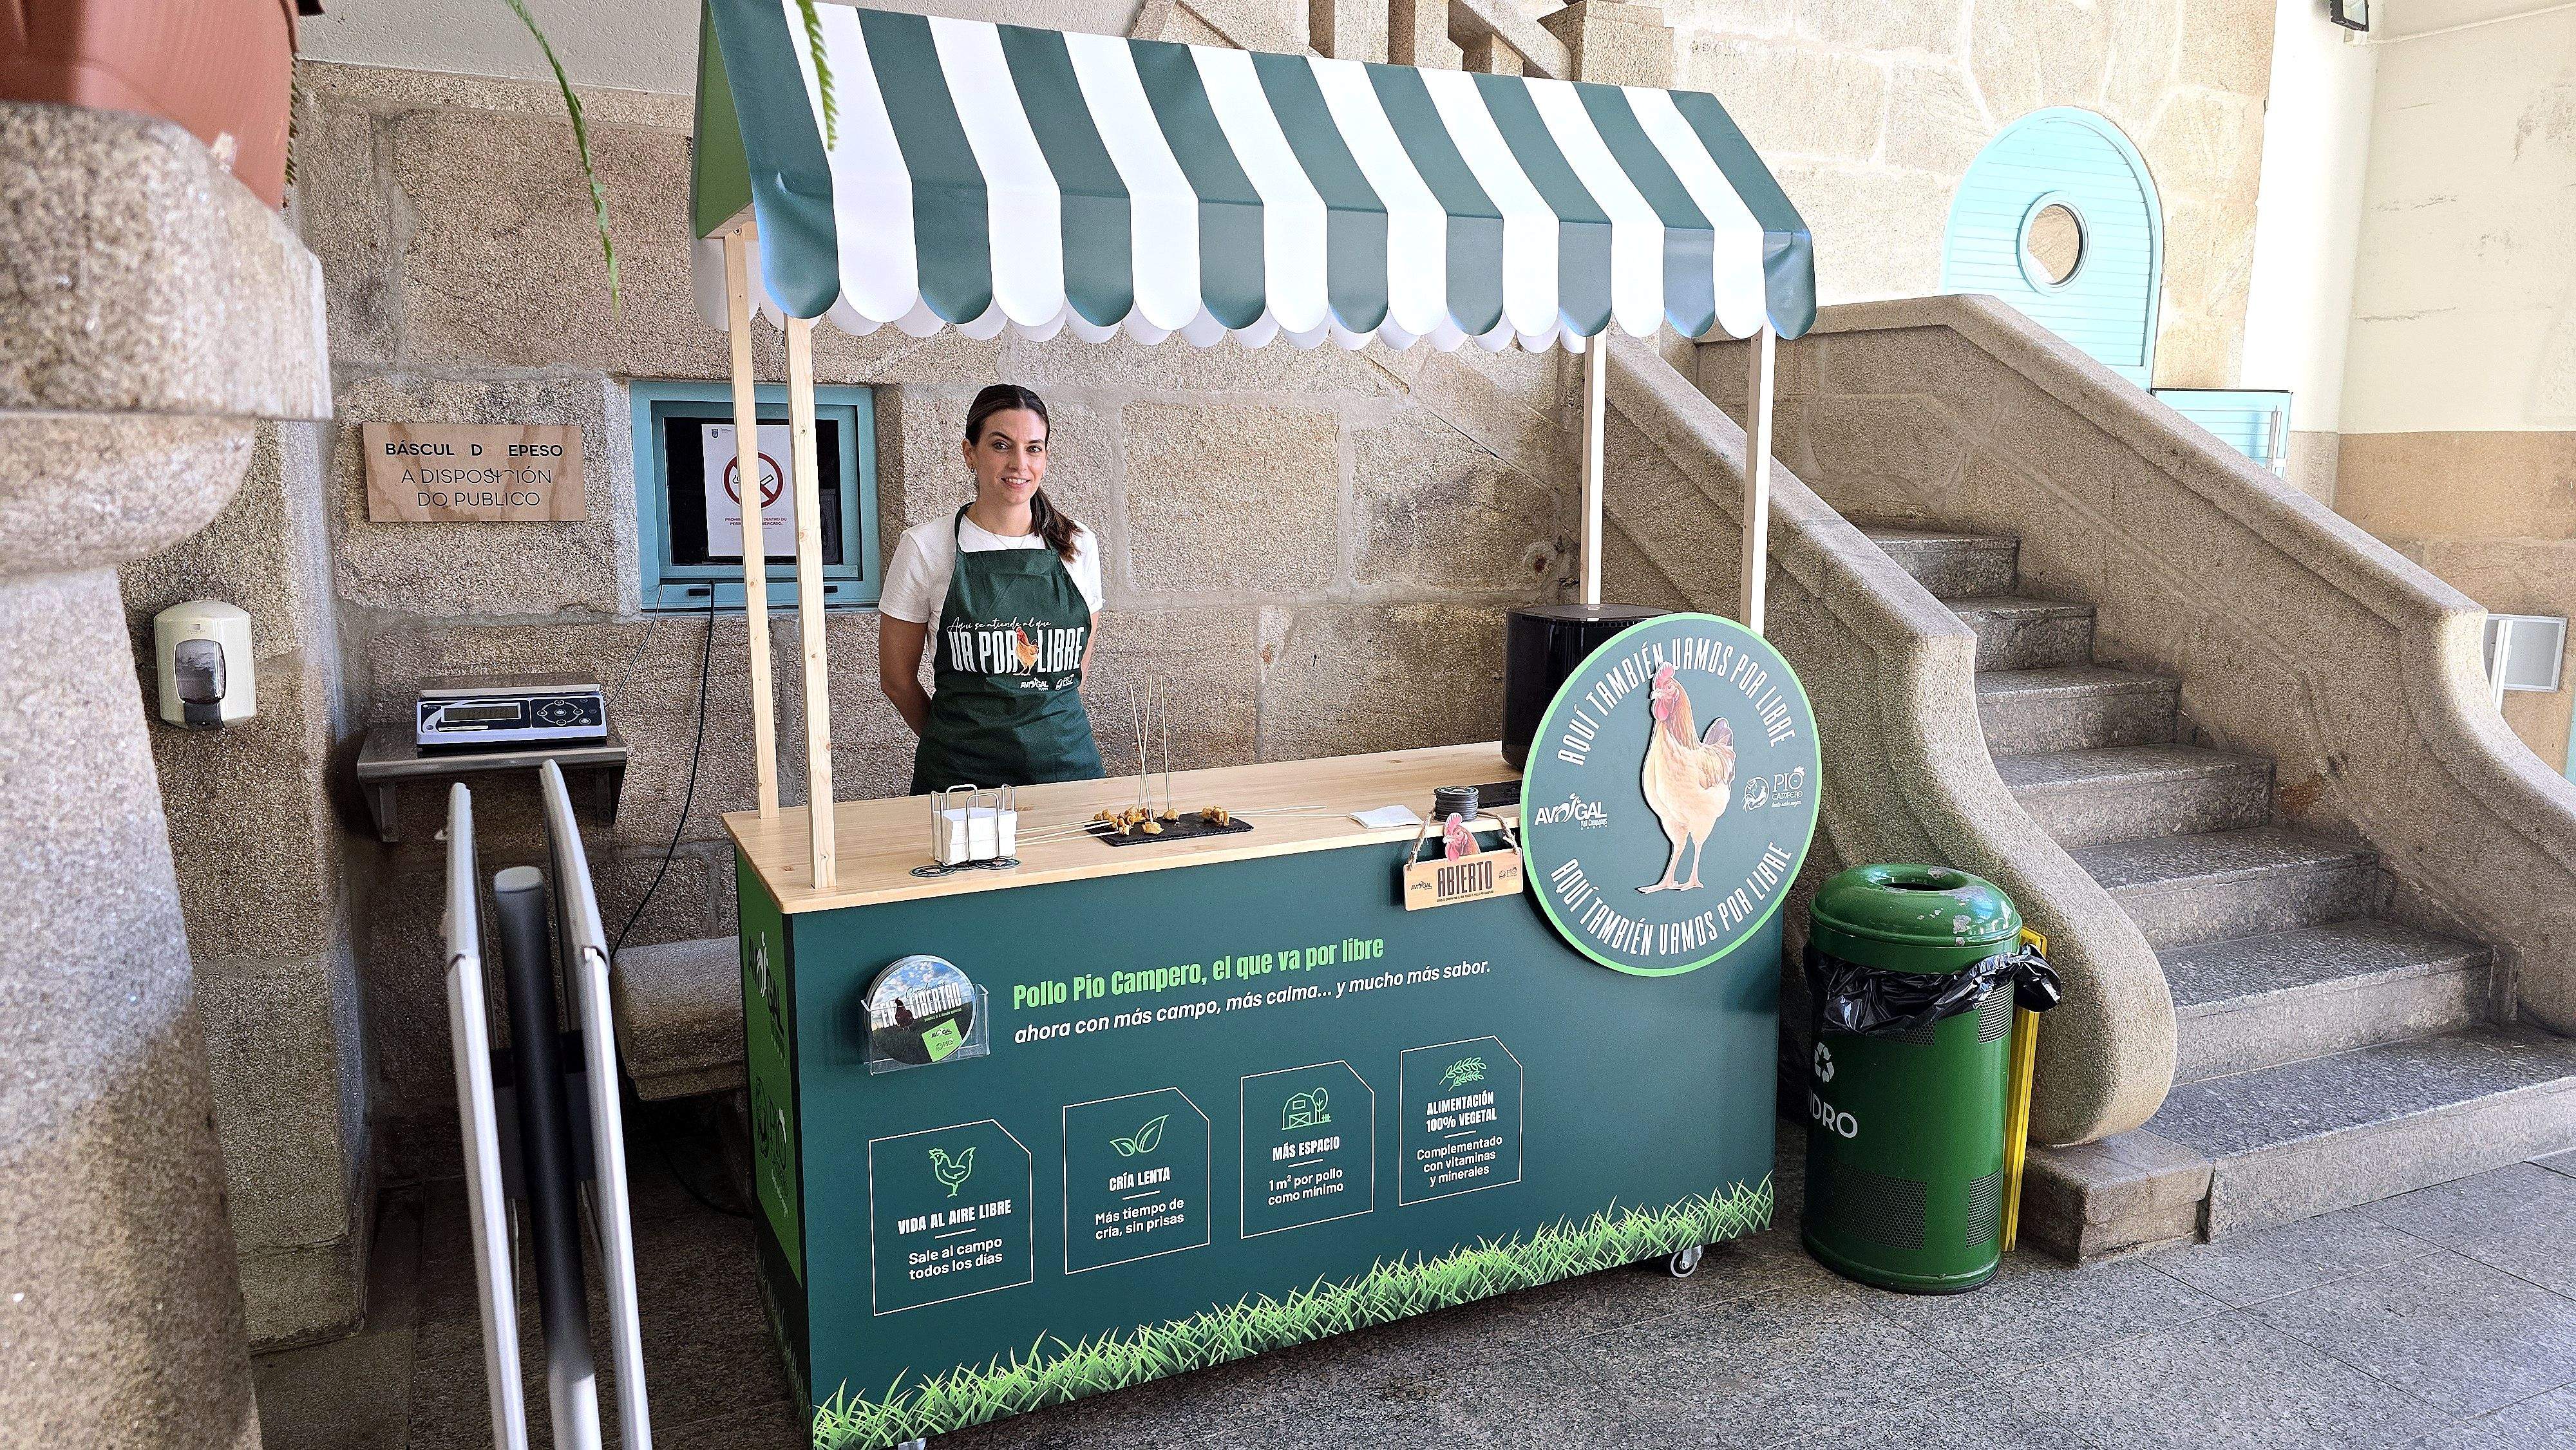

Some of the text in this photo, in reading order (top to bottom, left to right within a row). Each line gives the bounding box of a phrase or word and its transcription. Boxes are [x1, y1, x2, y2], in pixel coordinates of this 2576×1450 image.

[401, 469, 415, 484] A
[418, 491, 540, 507] DO PUBLICO
[978, 629, 1018, 674] POR
[1036, 626, 1084, 673] LIBRE
[1557, 703, 1600, 766] AQUÍ
[1585, 641, 1664, 717] TAMBIÉN
[1729, 653, 1768, 700] POR
[1754, 685, 1795, 748] LIBRE
[1437, 860, 1493, 898] ABIERTO
[1550, 858, 1600, 913] AQUÍ
[1579, 896, 1654, 956] TAMBIÉN
[1717, 887, 1754, 932] POR
[1745, 842, 1792, 901] LIBRE
[1014, 980, 1067, 1010] Pollo
[1110, 963, 1208, 993] Campero,
[1213, 955, 1231, 981] el
[1236, 950, 1273, 981] que
[1278, 948, 1301, 970] va
[1305, 943, 1338, 972] por
[1341, 937, 1385, 963] libre
[1014, 959, 1491, 1044] ahora con más campo, más calma... y mucho más sabor.
[1426, 1089, 1494, 1116] ALIMENTACIÓN
[1808, 1086, 1858, 1138] IDRO
[1426, 1107, 1497, 1133] 100% VEGETAL
[1272, 1136, 1340, 1162] MÁS ESPACIO
[1417, 1135, 1503, 1160] Complementado
[1423, 1151, 1496, 1172] con vitaminas
[1109, 1166, 1171, 1192] CRÍA LENTA
[1269, 1180, 1274, 1192] 1
[1294, 1174, 1314, 1189] por
[1316, 1167, 1343, 1185] pollo
[1430, 1165, 1490, 1188] y minerales
[1095, 1198, 1184, 1225] Más tiempo de
[1267, 1191, 1300, 1206] como
[897, 1199, 1012, 1235] VIDA AL AIRE LIBRE
[1095, 1214, 1184, 1240] cría, sin prisas
[909, 1238, 1003, 1265] Sale al campo
[909, 1253, 1003, 1281] todos los días
